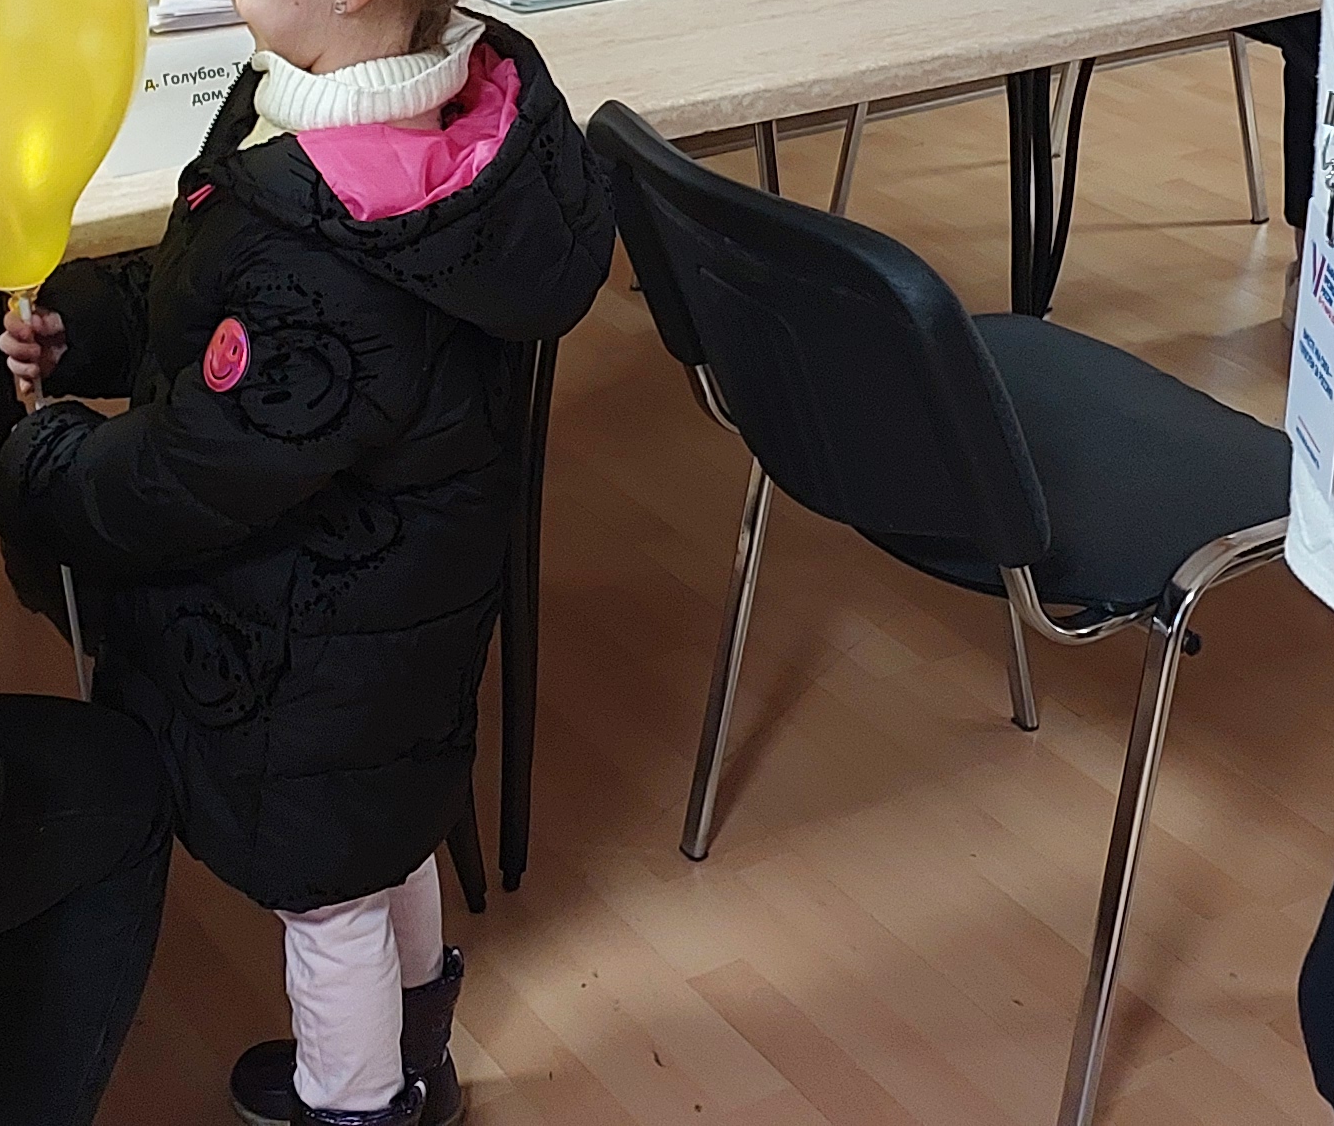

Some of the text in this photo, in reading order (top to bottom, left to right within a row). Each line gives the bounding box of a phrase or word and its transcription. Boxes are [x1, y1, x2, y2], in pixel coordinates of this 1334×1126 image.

[145, 79, 159, 92] д.
[163, 66, 230, 86] Голубое,
[192, 90, 223, 106] дом
